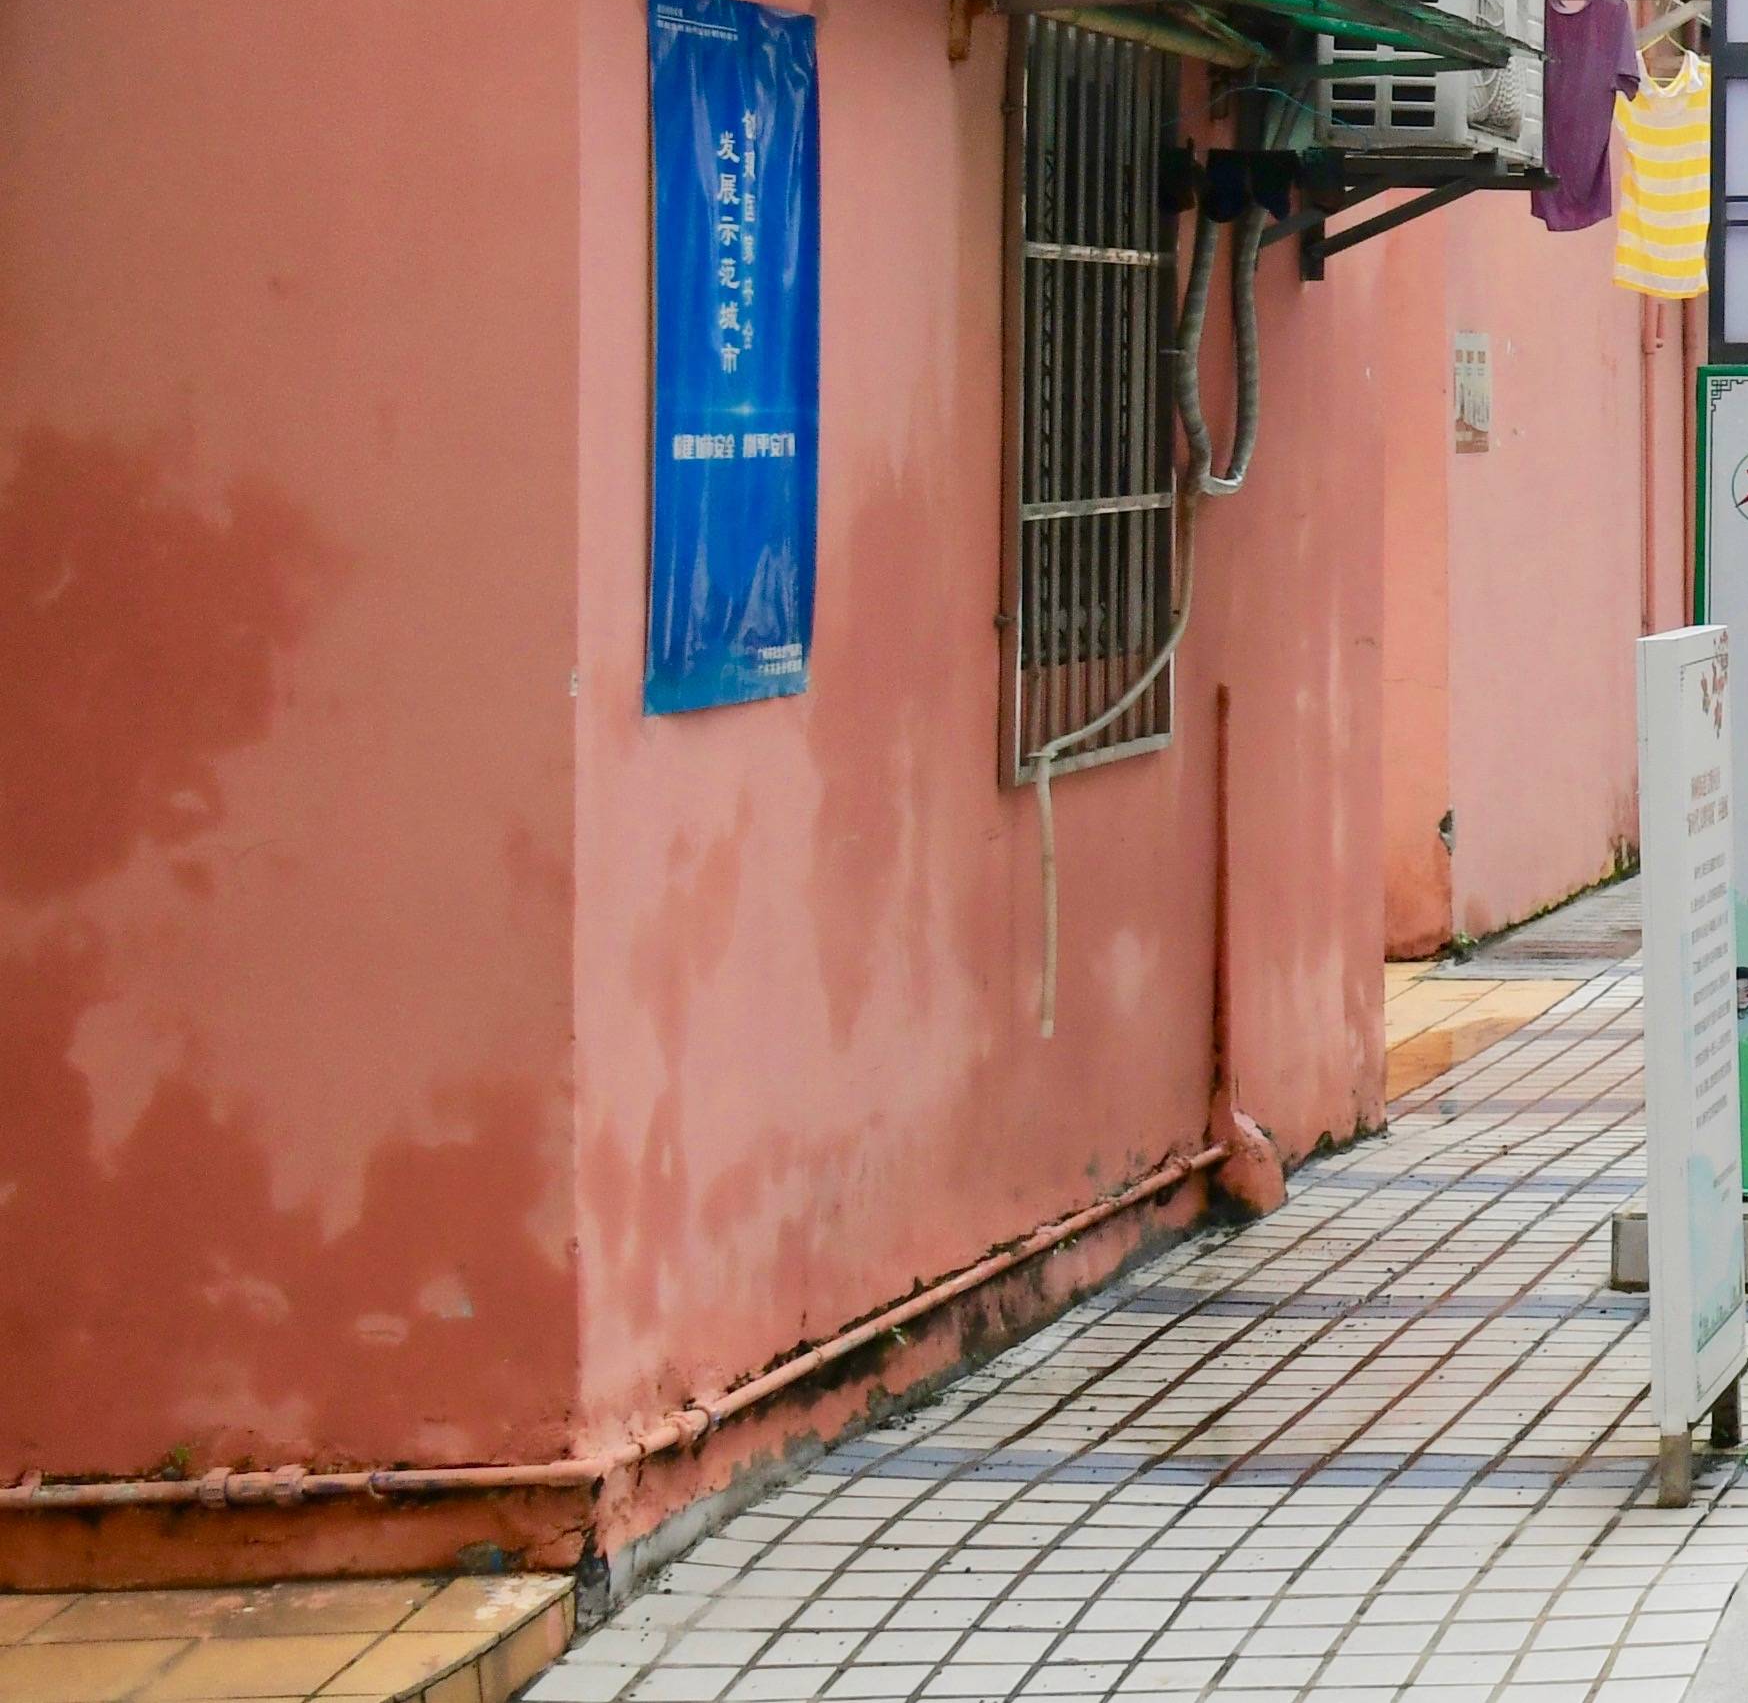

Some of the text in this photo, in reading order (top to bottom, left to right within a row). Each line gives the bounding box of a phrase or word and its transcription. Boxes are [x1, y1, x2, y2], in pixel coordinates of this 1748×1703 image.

[717, 131, 740, 374] 发展示范城市
